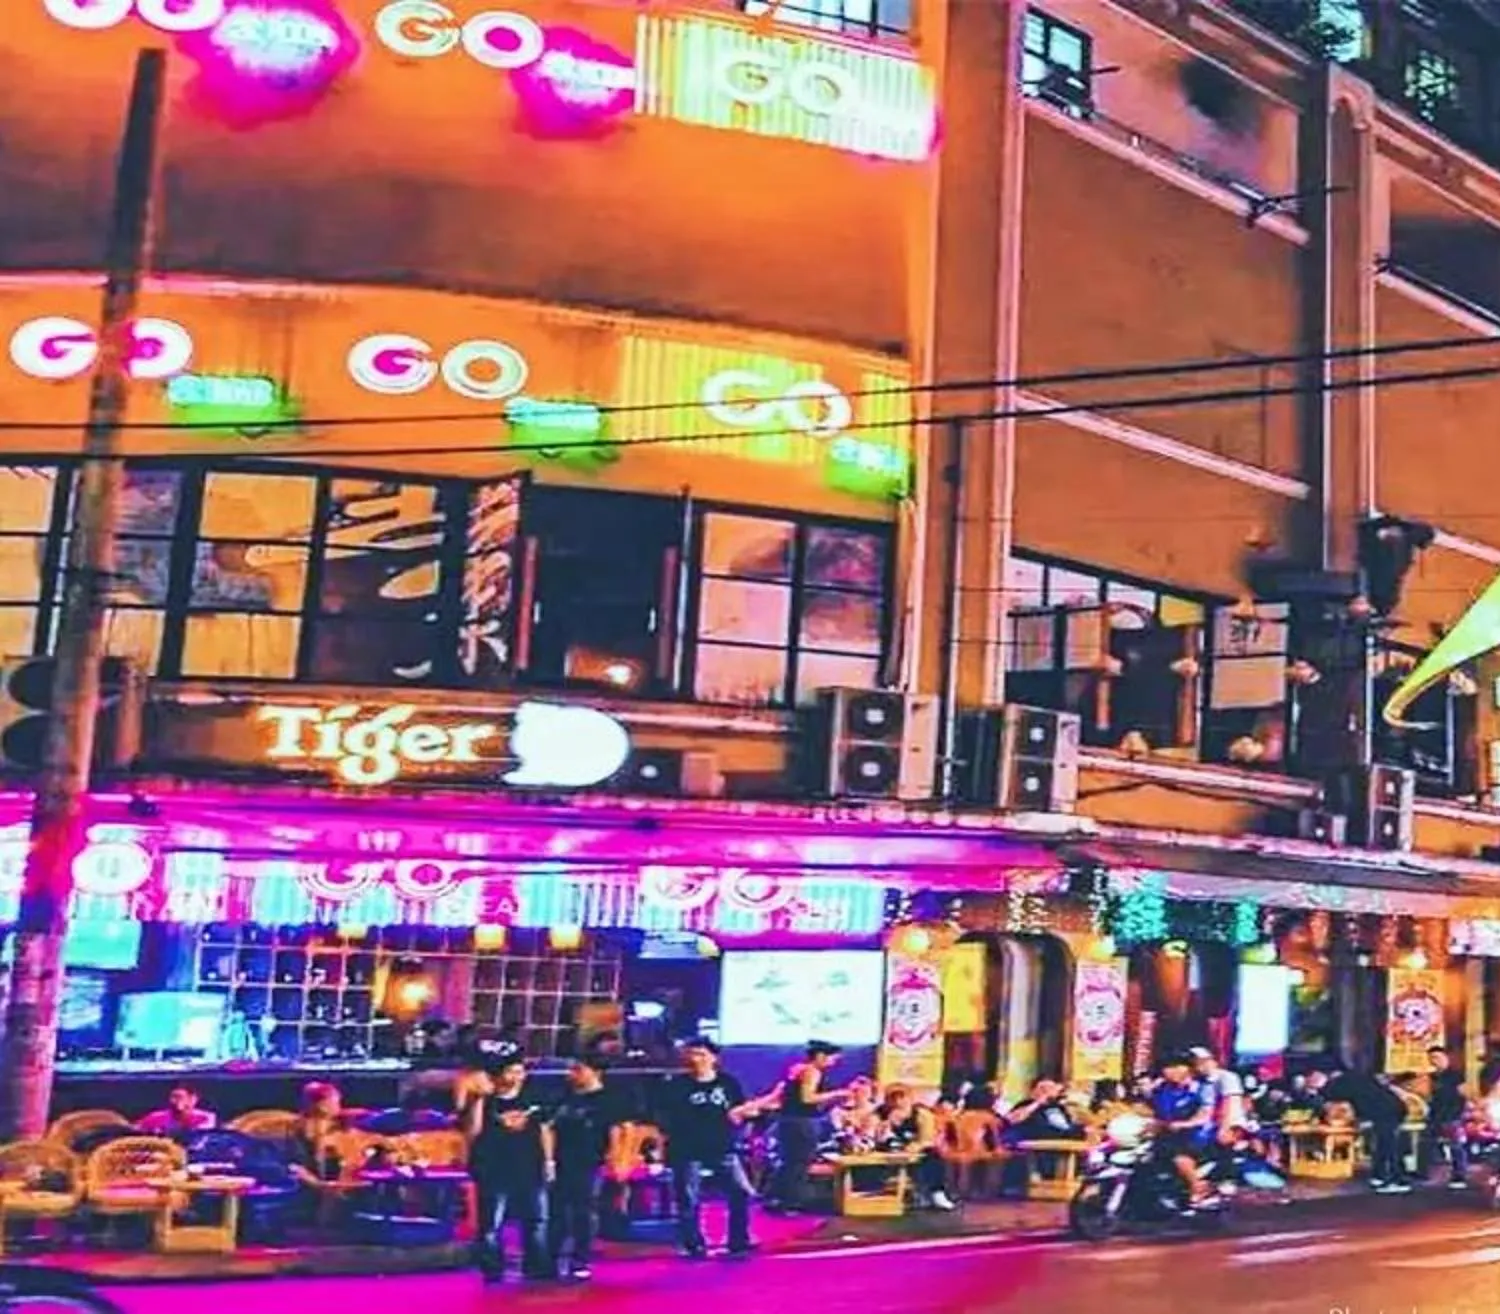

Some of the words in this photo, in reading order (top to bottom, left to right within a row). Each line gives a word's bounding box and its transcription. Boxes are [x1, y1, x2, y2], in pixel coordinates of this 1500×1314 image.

[347, 333, 529, 400] GO
[702, 369, 853, 438] GO
[257, 703, 499, 786] Tiger
